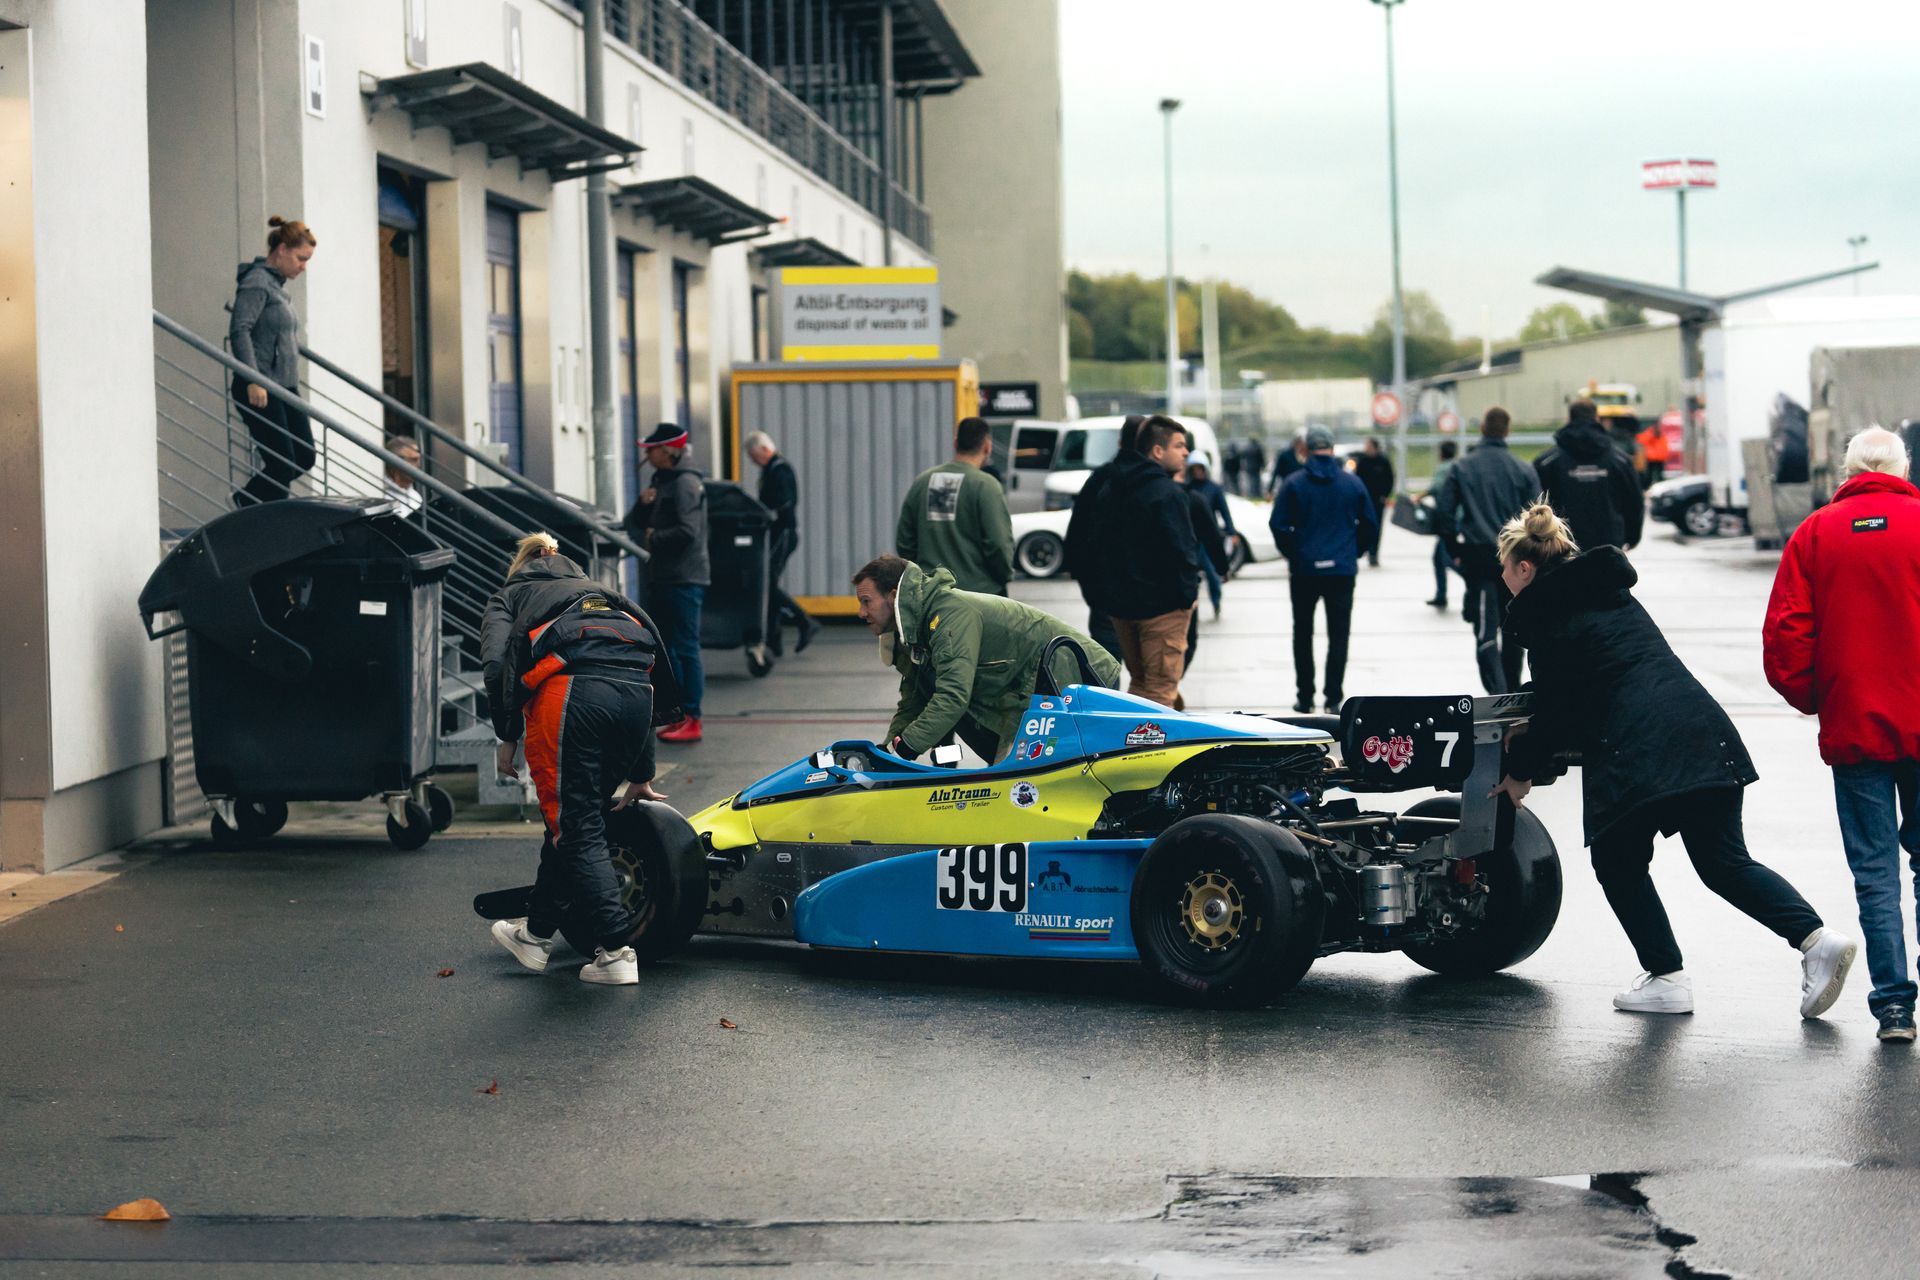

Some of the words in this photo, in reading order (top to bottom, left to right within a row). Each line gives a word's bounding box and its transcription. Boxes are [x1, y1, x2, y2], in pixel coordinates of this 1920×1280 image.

[795, 294, 928, 313] Altöl-Entsorgung
[795, 316, 849, 331] disposal
[855, 317, 868, 330] of
[872, 318, 907, 330] waste
[912, 317, 928, 330] oil
[1025, 717, 1056, 736] elf
[1434, 732, 1459, 767] 7
[939, 843, 1026, 913] 399
[1015, 914, 1071, 928] RENAULT
[1074, 915, 1114, 931] sport
